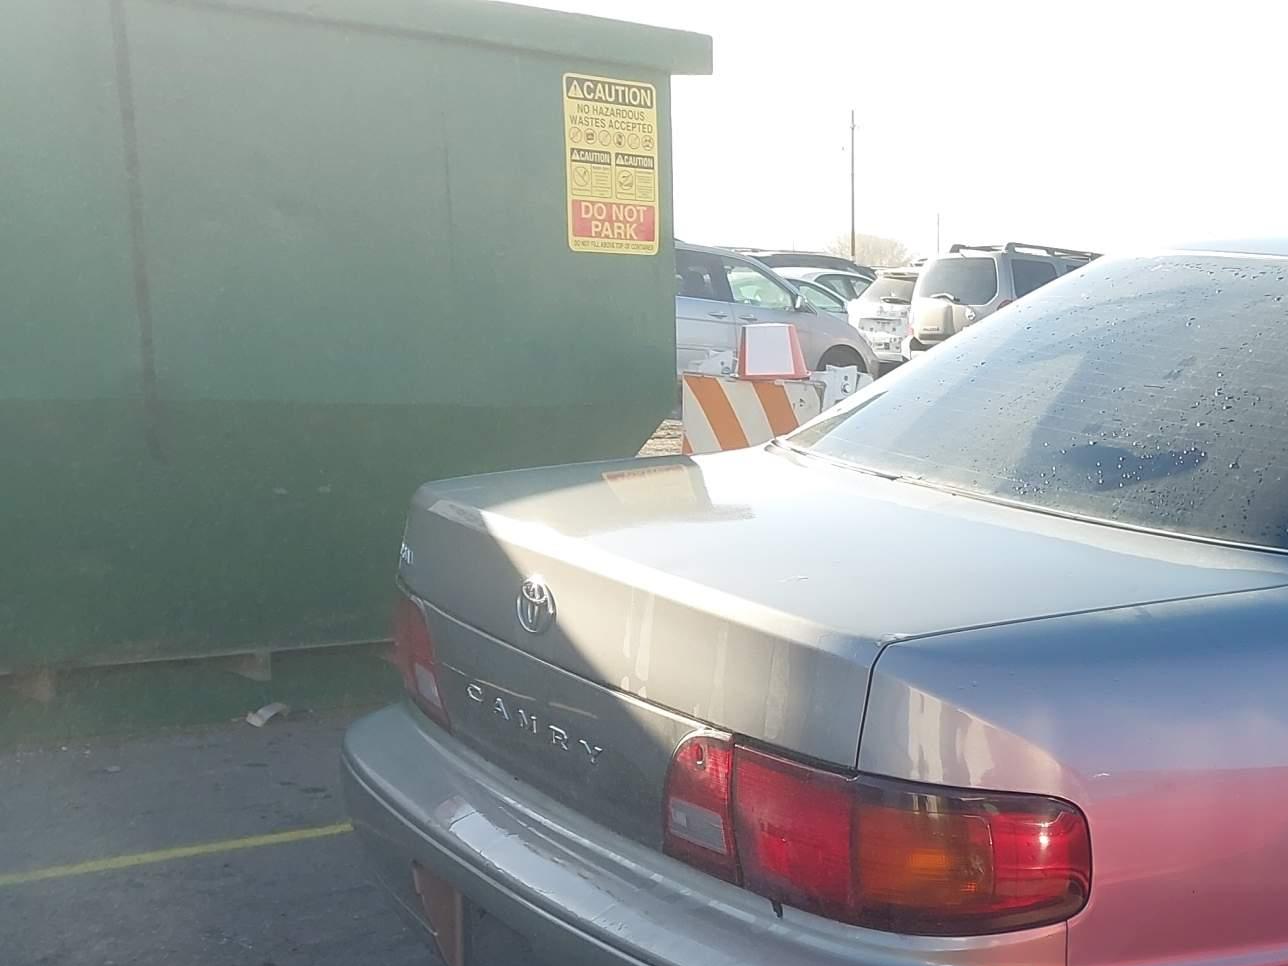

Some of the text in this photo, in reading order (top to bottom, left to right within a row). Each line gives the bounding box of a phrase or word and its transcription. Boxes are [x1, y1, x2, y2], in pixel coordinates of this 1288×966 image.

[583, 81, 652, 107] CAUTION
[577, 103, 645, 121] NO HAZARDOUS
[569, 114, 653, 134] WASTES ACCEPTED
[579, 151, 610, 163] CAUTION
[624, 155, 654, 168] CAUTION
[581, 201, 647, 223] DO NOT
[591, 220, 638, 240] PARK
[466, 683, 604, 764] CAMRY
